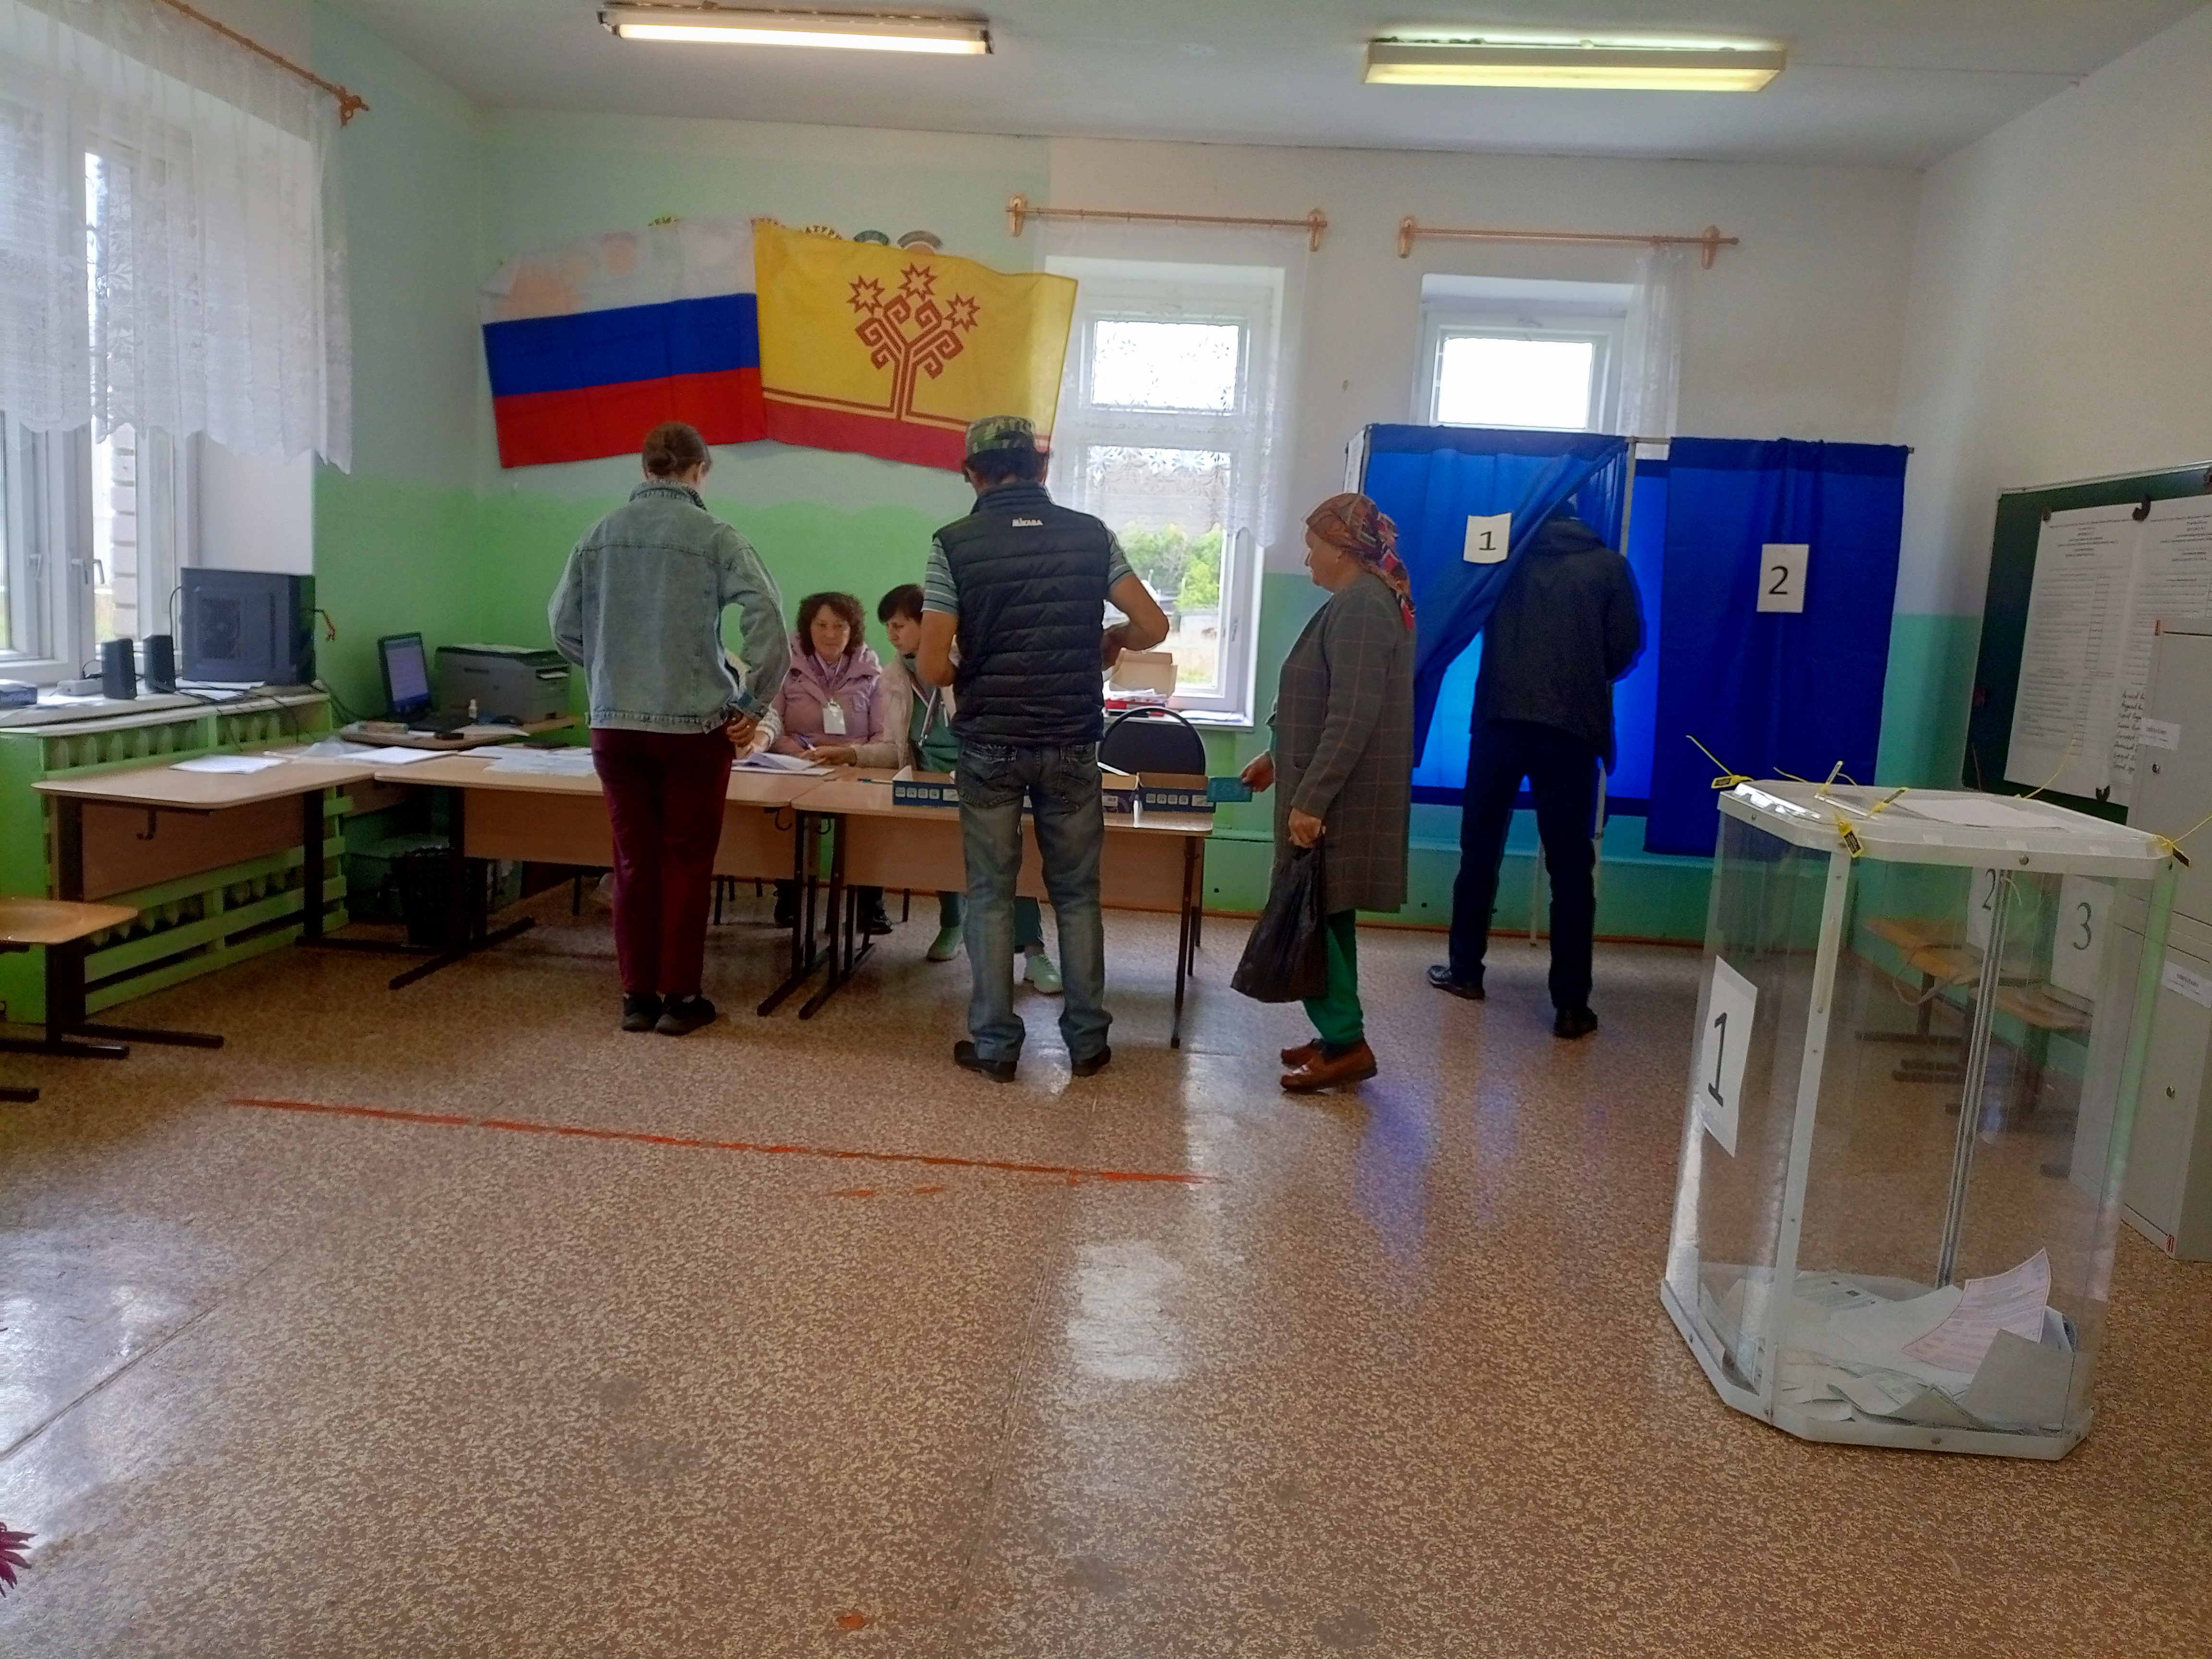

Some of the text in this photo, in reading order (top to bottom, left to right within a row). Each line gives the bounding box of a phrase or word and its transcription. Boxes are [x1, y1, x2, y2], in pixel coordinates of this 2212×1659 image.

[1479, 531, 1496, 551] 1
[1768, 565, 1789, 595] 2
[1982, 868, 1996, 911] 2
[2072, 902, 2092, 950] 3
[1708, 1012, 1727, 1107] 1
